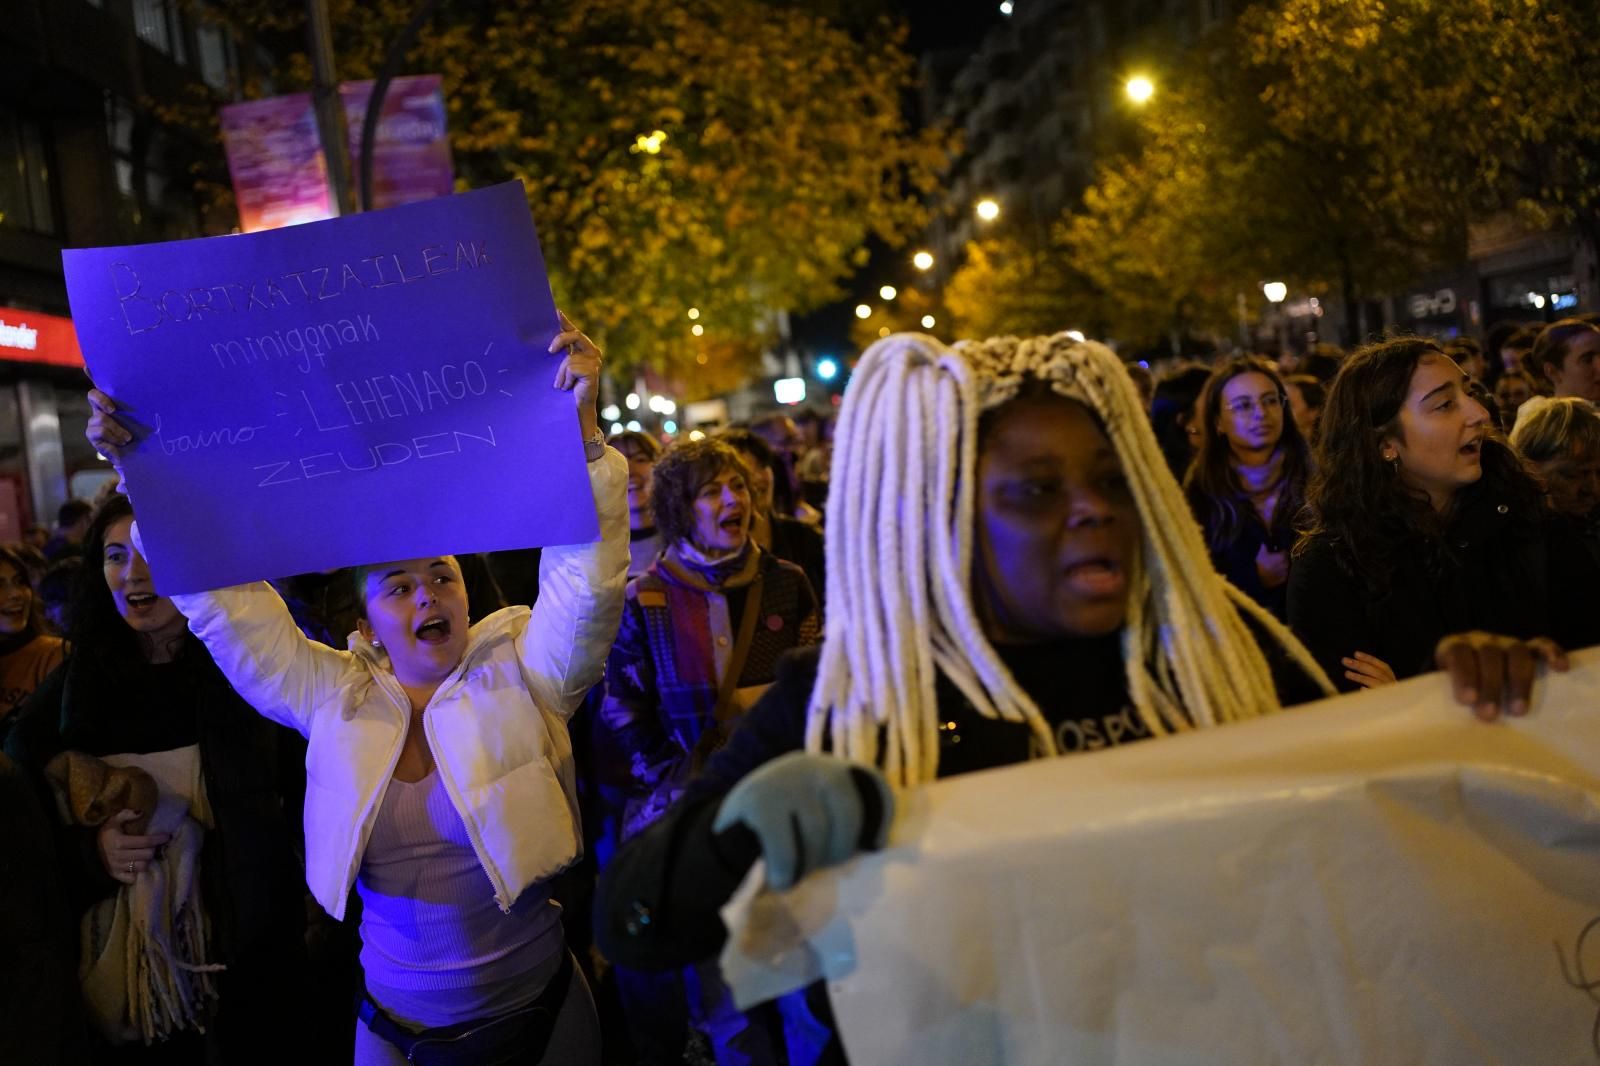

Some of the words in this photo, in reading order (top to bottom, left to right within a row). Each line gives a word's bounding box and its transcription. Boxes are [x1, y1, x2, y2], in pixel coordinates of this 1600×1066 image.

[110, 241, 492, 335] BORTXATZAILEAK
[154, 412, 266, 456] baino
[301, 361, 487, 431] LEHENAGO
[253, 425, 496, 487] ZEUDEN
